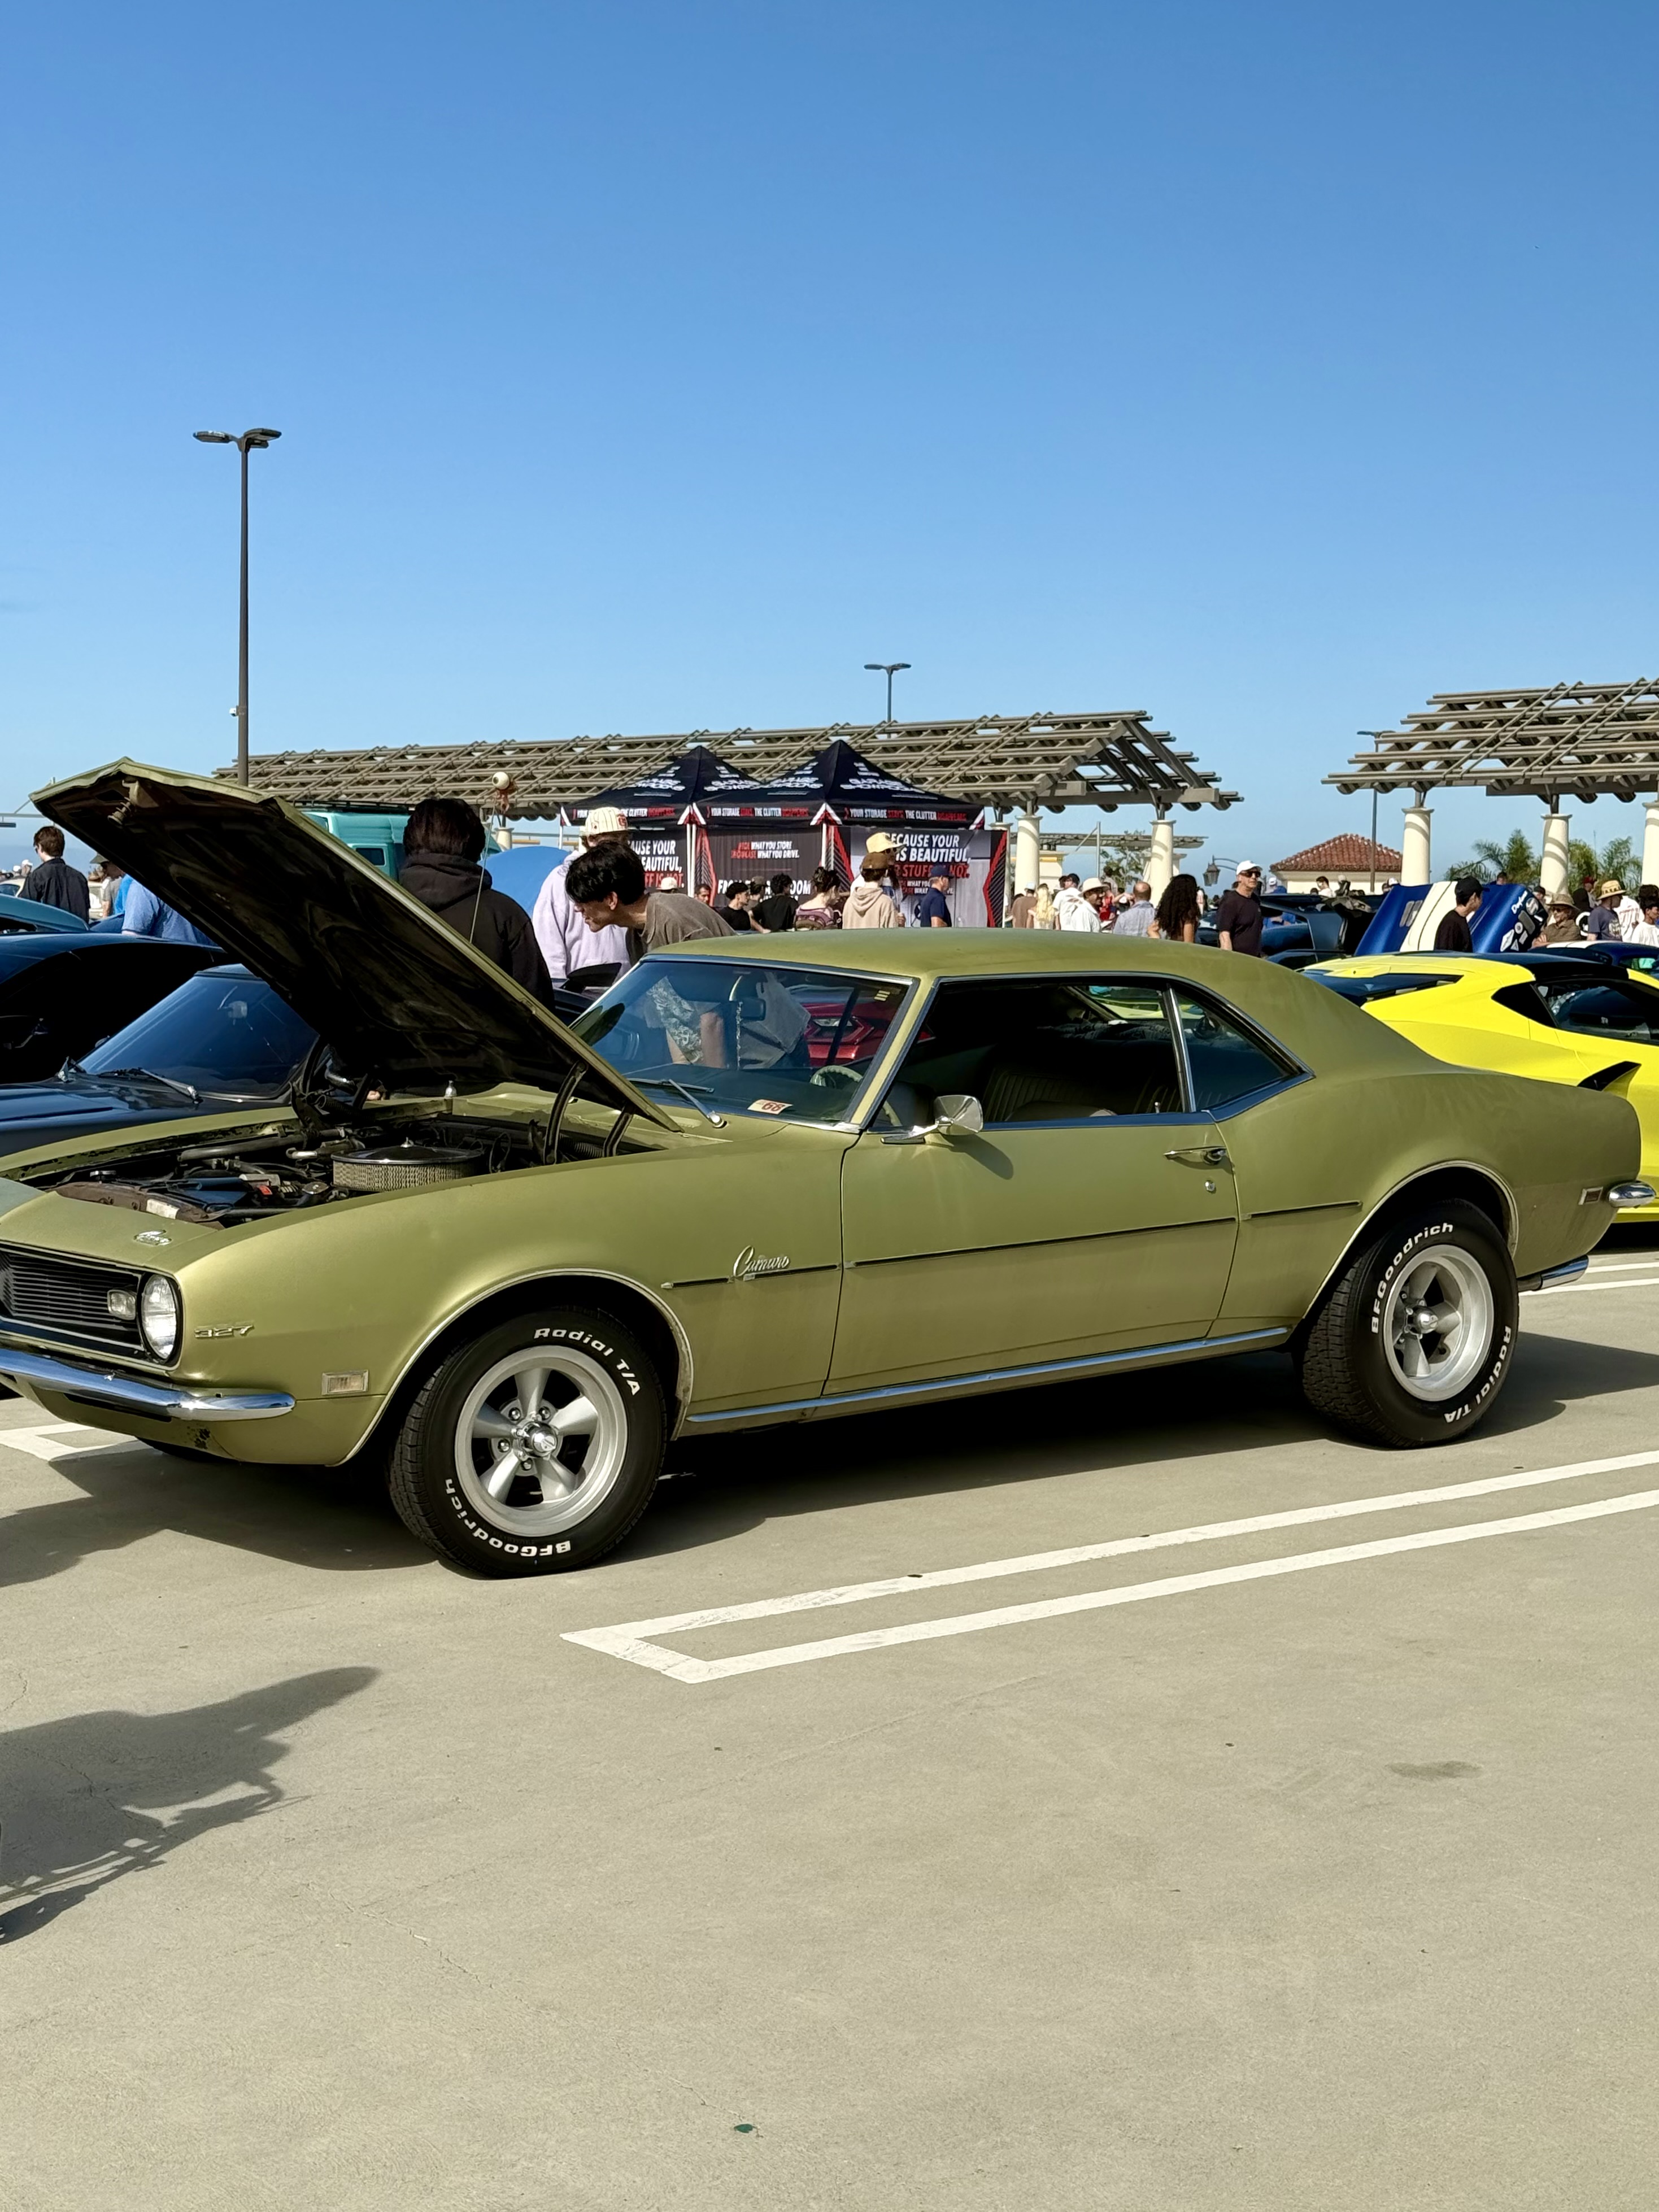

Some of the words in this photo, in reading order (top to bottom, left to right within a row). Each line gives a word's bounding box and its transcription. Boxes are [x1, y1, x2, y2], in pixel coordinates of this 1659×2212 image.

[711, 808, 721, 816] YOUR
[722, 808, 740, 816] STORAGE
[754, 808, 763, 816] THE
[763, 808, 781, 816] CLUTTER
[850, 808, 864, 817] YOUR
[864, 809, 887, 818] STORAGE
[905, 810, 916, 819] THE
[916, 811, 937, 820] CLUTTER
[652, 840, 676, 855] YOUR
[777, 841, 793, 850] STORE
[932, 835, 960, 847] YOUR
[757, 850, 772, 859] WHAT
[772, 850, 782, 859] YOU
[909, 848, 971, 864] BEAUTIFUL,
[641, 856, 682, 873] EAUTIFUL,
[761, 1102, 786, 1112] 68
[734, 1245, 789, 1277] Camaro
[1371, 1222, 1453, 1334] BFGoodrich
[194, 1325, 254, 1338] 327
[534, 1328, 615, 1356] Radial
[617, 1359, 641, 1395] T/A
[1475, 1325, 1512, 1405] Radial
[1444, 1404, 1471, 1423] T/A
[446, 1479, 572, 1557] BFGoodrich
